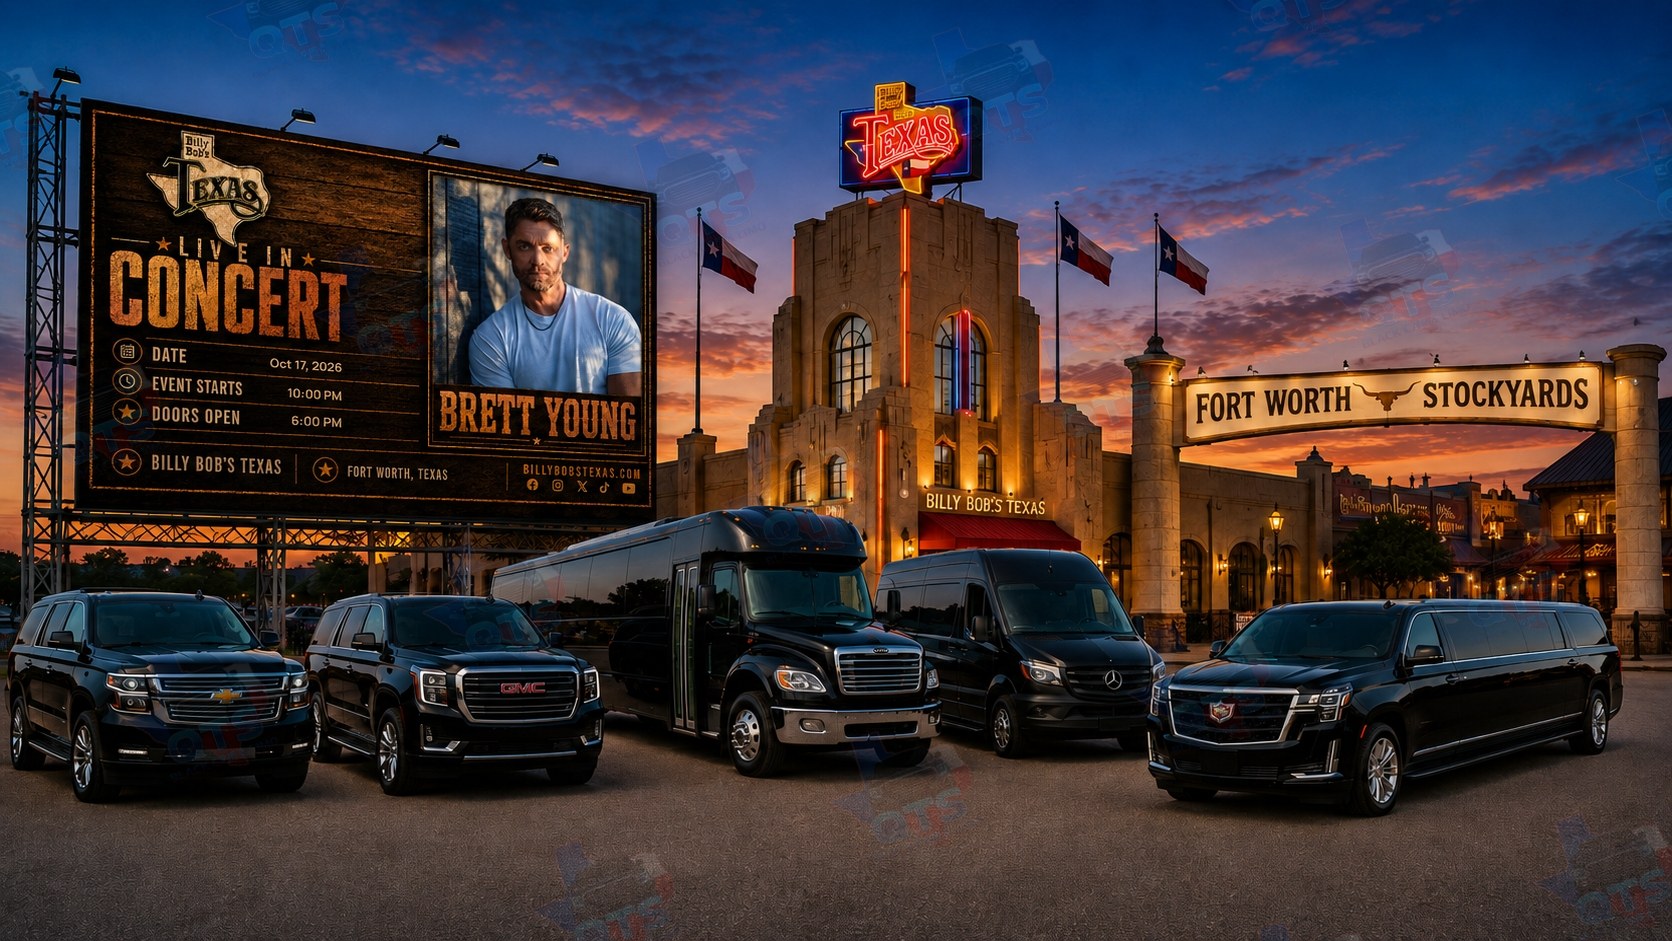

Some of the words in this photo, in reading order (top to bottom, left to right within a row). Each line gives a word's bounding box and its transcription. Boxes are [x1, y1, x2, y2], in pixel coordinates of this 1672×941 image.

[185, 136, 209, 151] Billy
[853, 114, 953, 178] TEXAS
[162, 156, 265, 220] TEXAS
[179, 236, 248, 263] LIVE
[267, 246, 292, 267] IN
[109, 250, 347, 342] CONCERT
[152, 347, 187, 364] DATE
[269, 358, 292, 370] Oct
[295, 359, 309, 373] 17,
[312, 361, 342, 373] 2026
[152, 376, 192, 393] EVENT
[196, 379, 243, 396] STARTS
[288, 388, 321, 400] 10:00
[324, 390, 342, 401] PM
[1196, 390, 1256, 424] FORT
[1264, 386, 1351, 416] WORTH
[1423, 378, 1588, 410] STOCKYARDS
[152, 406, 199, 423] DOORS
[205, 408, 240, 425] OPEN
[291, 415, 320, 427] 6:00
[323, 417, 342, 428] PM
[439, 390, 535, 436] BRETT
[544, 397, 636, 441] YOUNG
[152, 454, 190, 472] BILLY
[196, 456, 235, 473] BOB'S
[240, 458, 281, 475] TEXAS
[347, 465, 371, 478] FORT
[376, 467, 414, 481] WORTH,
[418, 468, 448, 481] TEXAS
[523, 463, 641, 480] BILLYBOBSTEXAS.COM
[926, 493, 961, 510] BILLY
[1006, 499, 1045, 515] TEXAS
[501, 682, 545, 694] GMC
